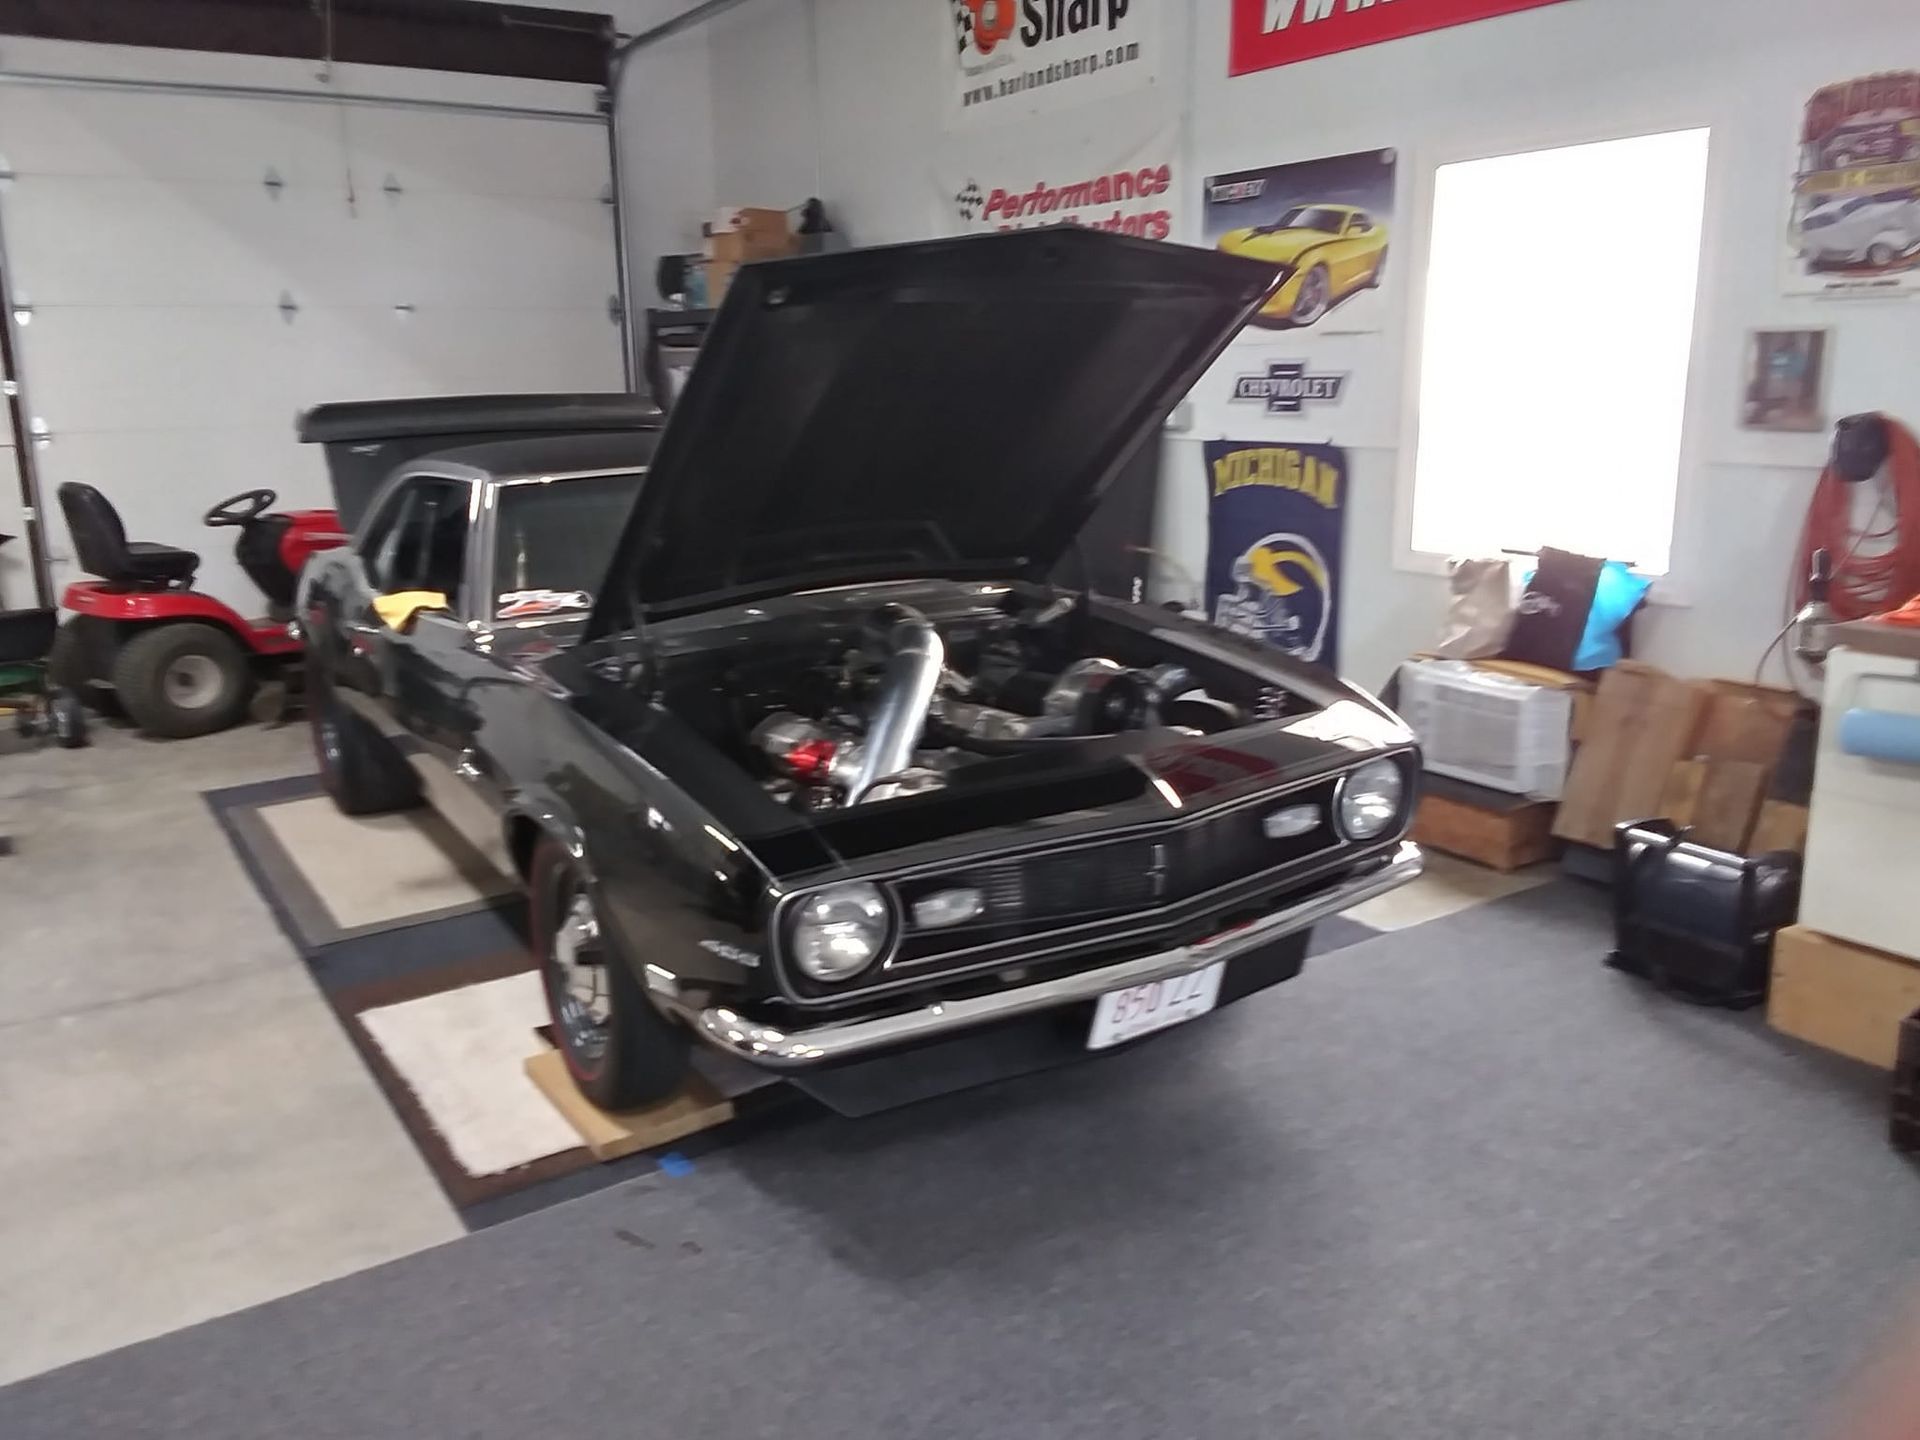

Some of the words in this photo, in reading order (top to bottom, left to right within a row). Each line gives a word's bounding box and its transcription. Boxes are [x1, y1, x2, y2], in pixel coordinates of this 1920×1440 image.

[982, 163, 1171, 221] Performance
[1239, 378, 1337, 398] CHEVROLET
[1213, 447, 1339, 509] MICHIGAN
